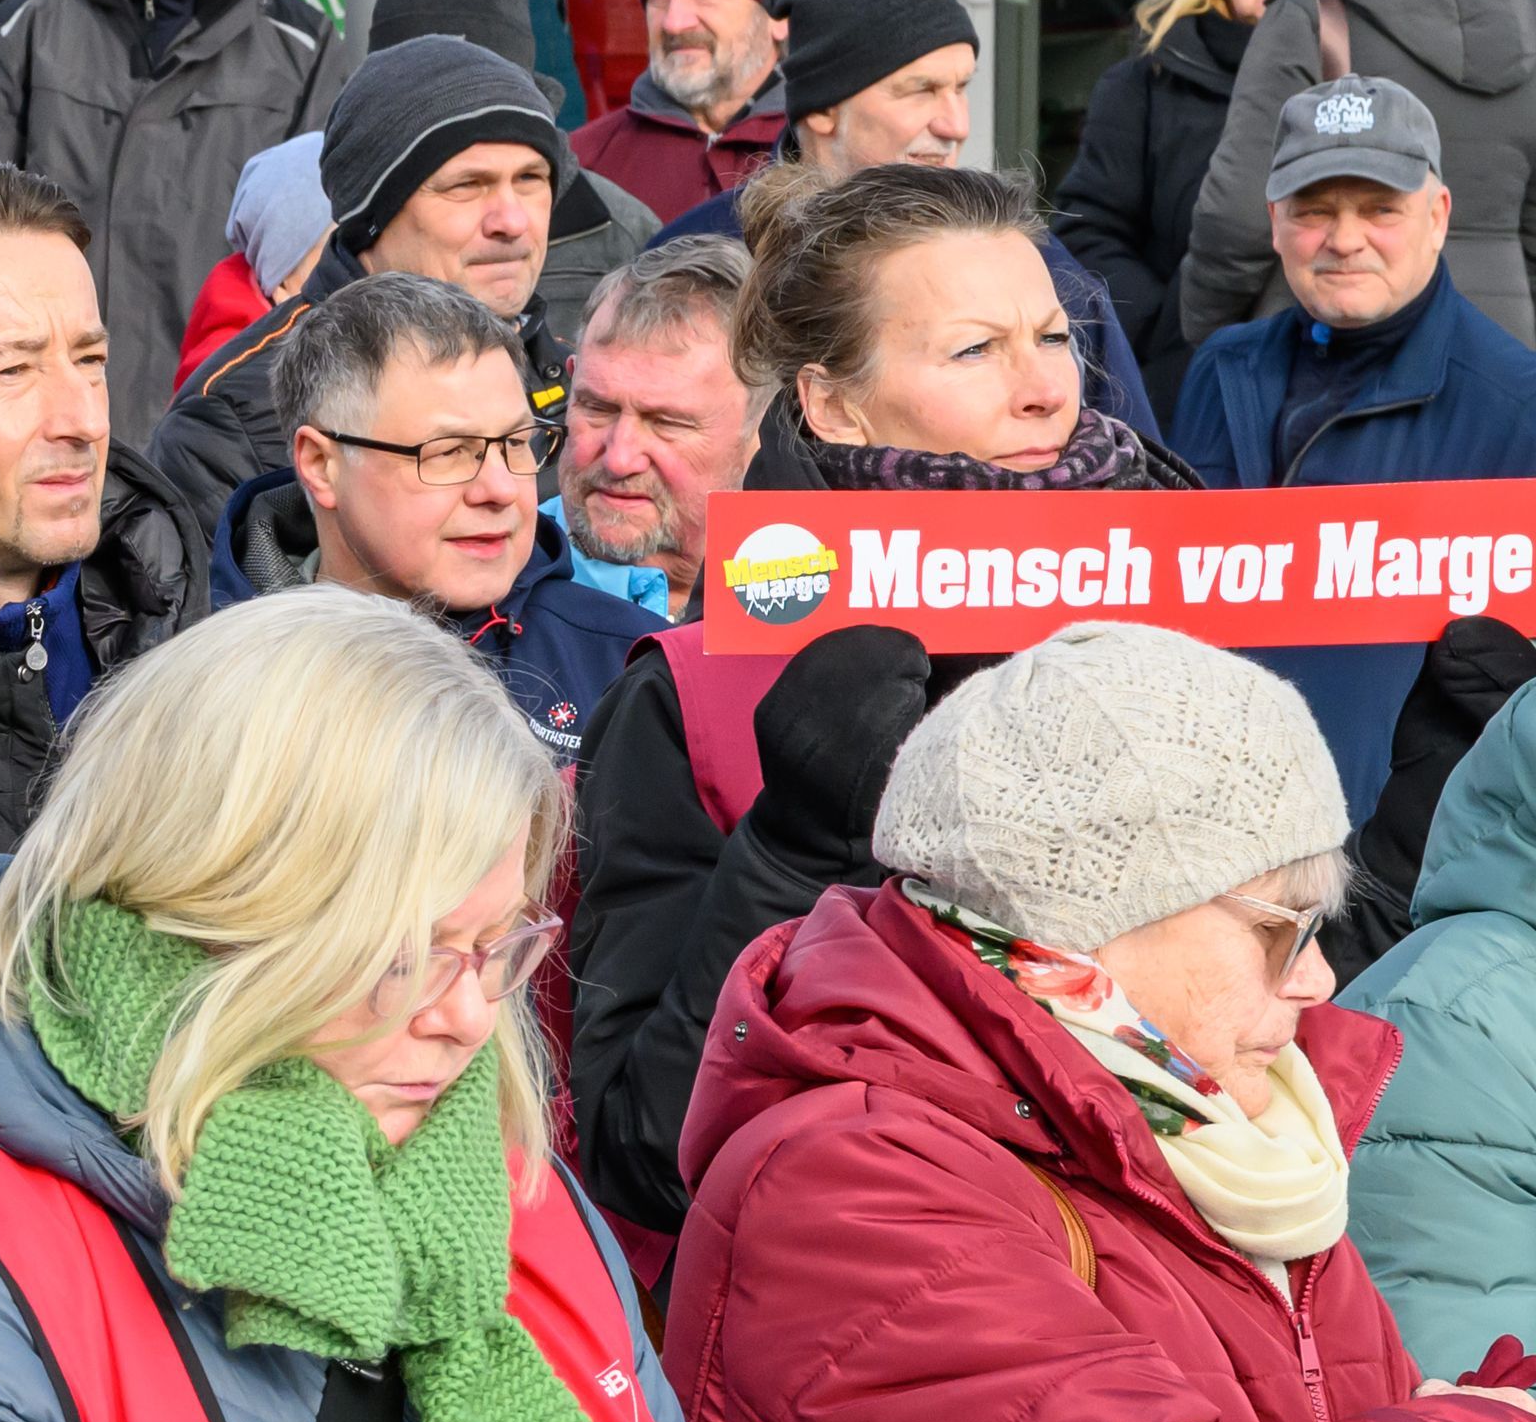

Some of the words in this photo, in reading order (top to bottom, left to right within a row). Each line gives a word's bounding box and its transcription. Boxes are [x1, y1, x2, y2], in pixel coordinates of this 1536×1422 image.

[1316, 96, 1373, 117] CRAZY
[1342, 109, 1375, 126] MAN
[723, 543, 839, 588] Mensch
[848, 528, 1152, 609] Mensch
[1177, 542, 1294, 603] vor
[1313, 520, 1534, 616] Marge
[745, 573, 831, 602] Marge
